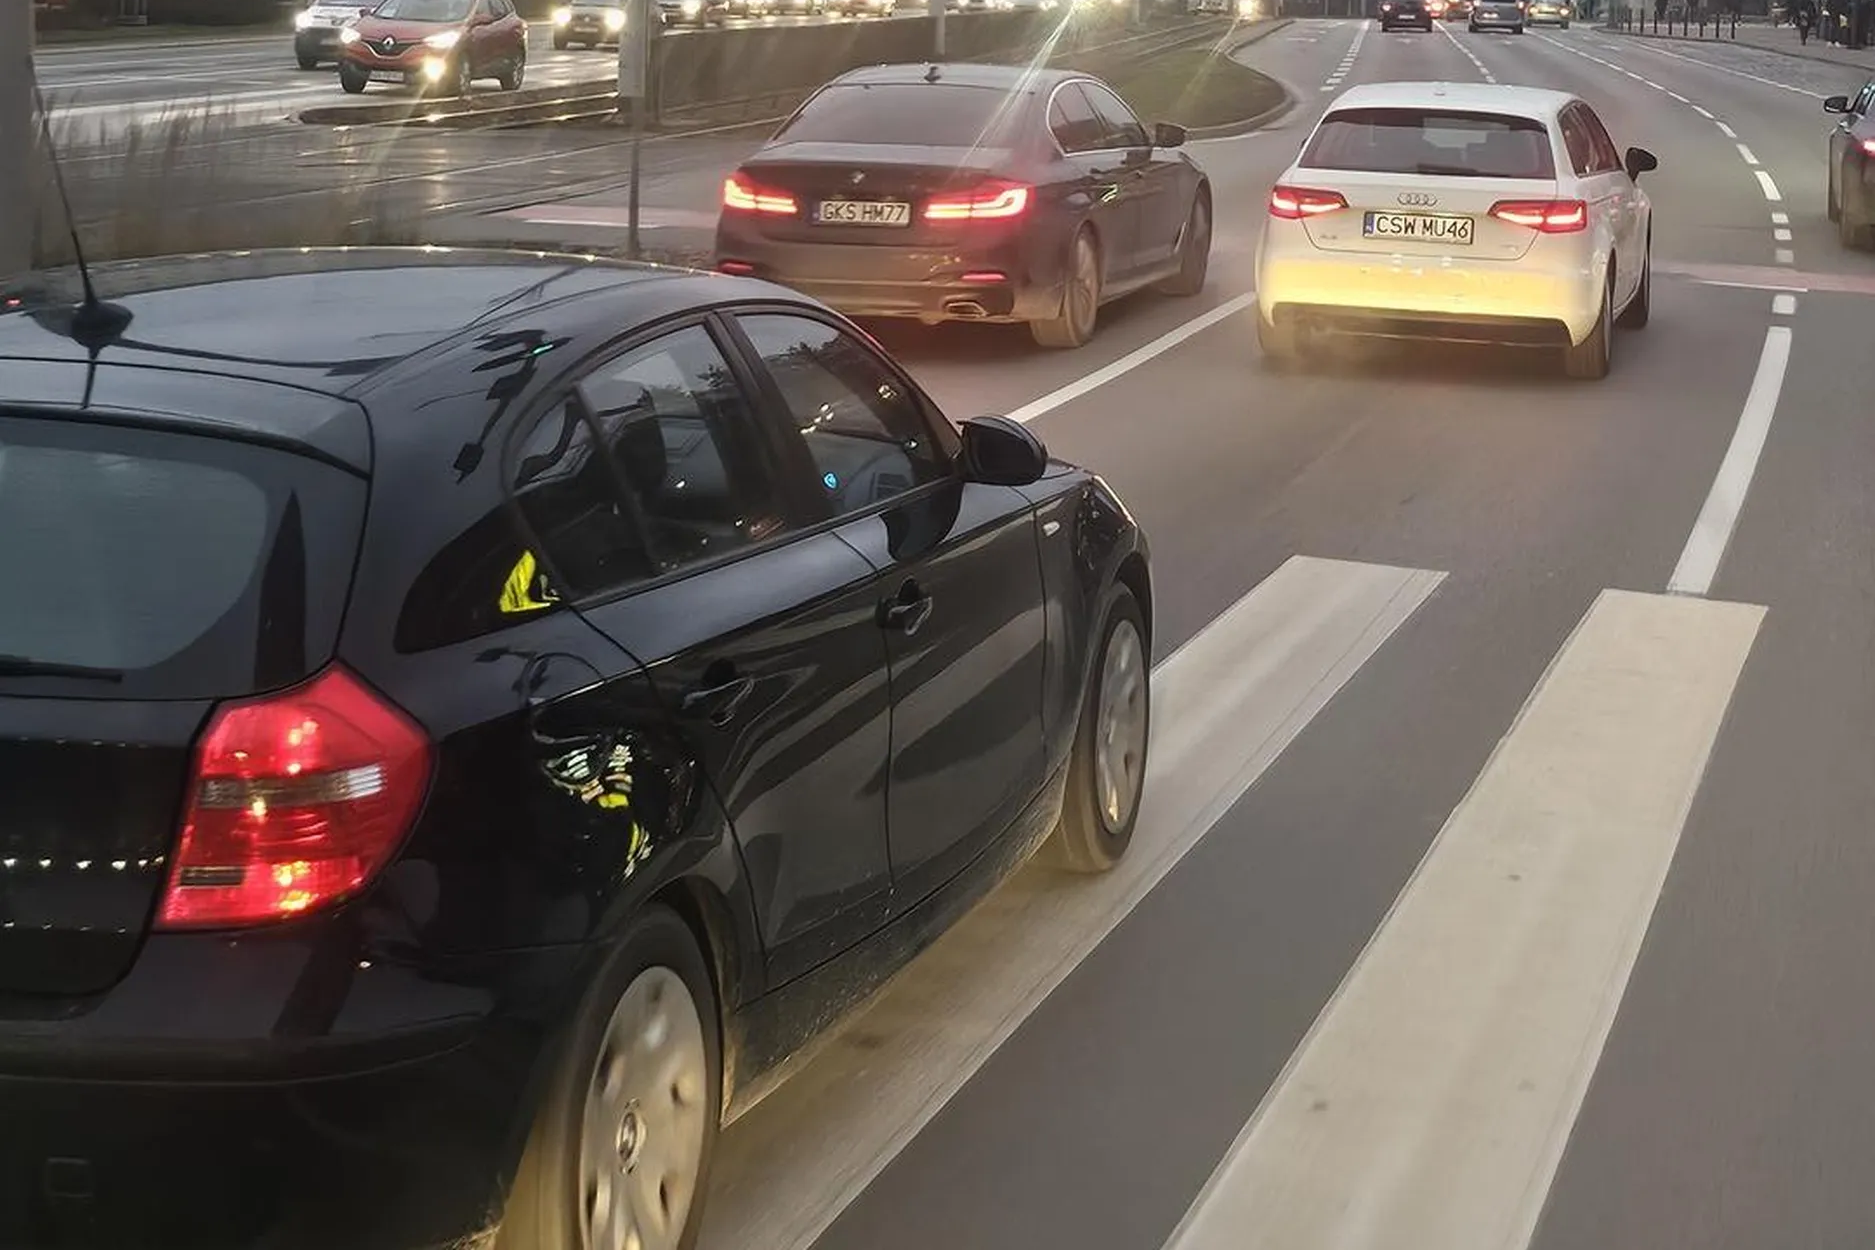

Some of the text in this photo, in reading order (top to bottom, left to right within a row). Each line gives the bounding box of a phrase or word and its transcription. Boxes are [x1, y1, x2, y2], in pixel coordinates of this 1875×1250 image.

[824, 203, 906, 221] GKS HM77
[1376, 215, 1469, 239] CSW MU46
